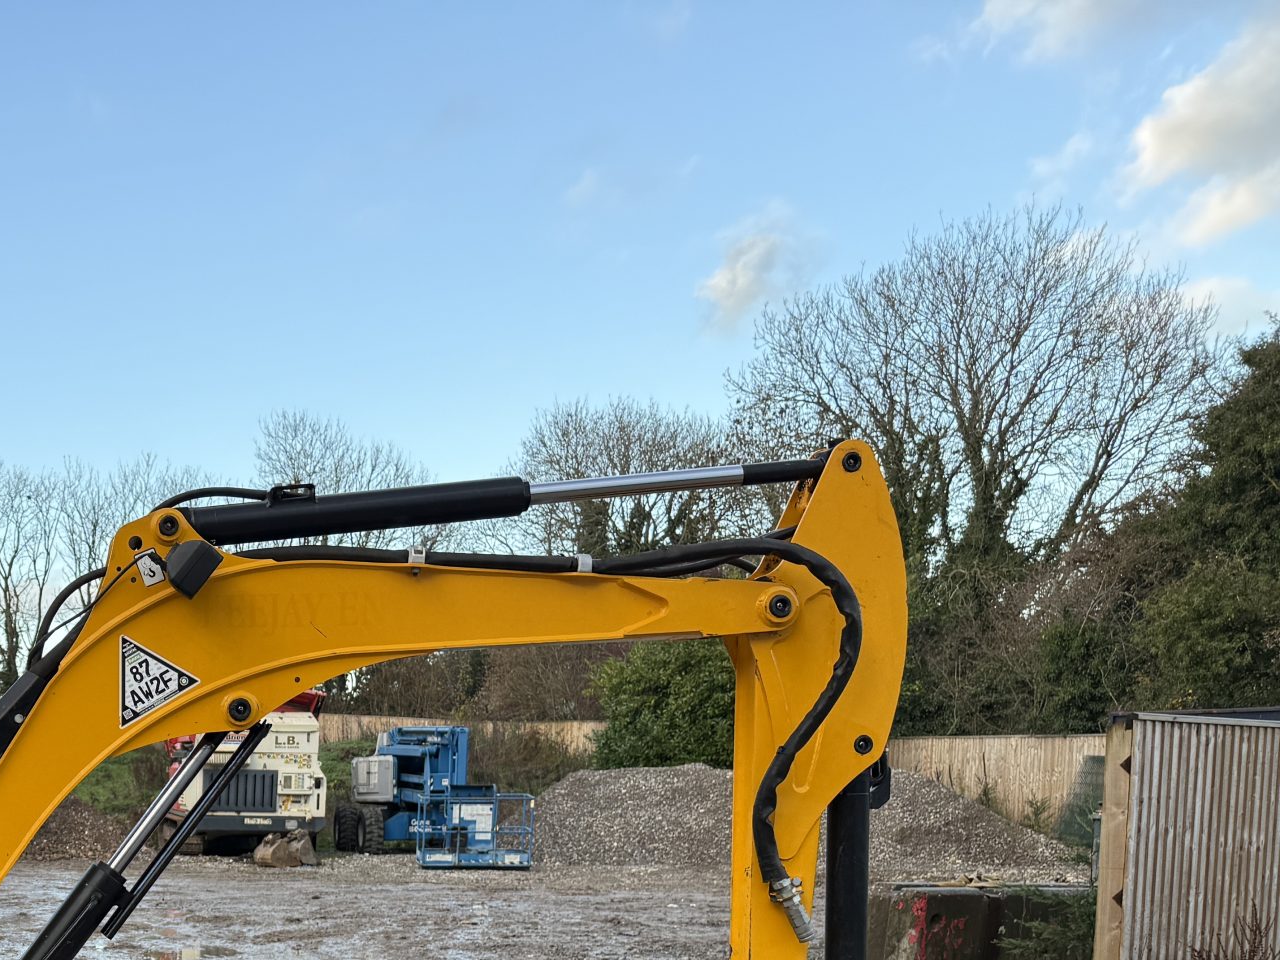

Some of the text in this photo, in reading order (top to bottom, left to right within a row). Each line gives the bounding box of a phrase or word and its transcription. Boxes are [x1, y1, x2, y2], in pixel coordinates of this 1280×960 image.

[129, 658, 151, 683] 87
[129, 669, 173, 708] AW2F
[275, 735, 300, 746] L.B.
